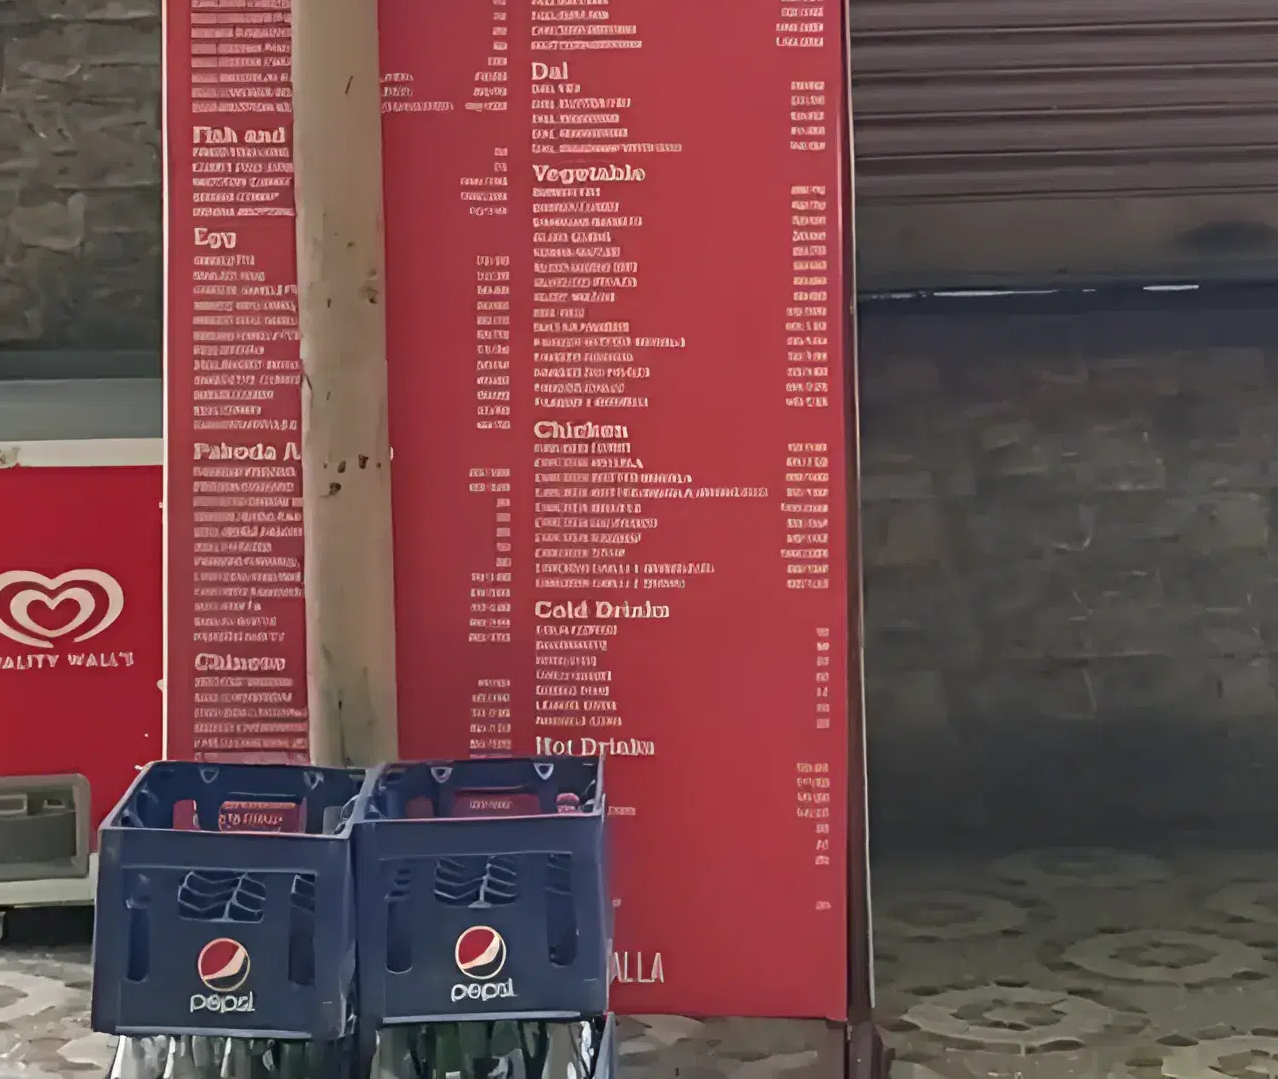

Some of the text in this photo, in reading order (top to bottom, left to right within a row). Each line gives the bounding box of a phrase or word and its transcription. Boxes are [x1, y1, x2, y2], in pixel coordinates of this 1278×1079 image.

[531, 61, 569, 81] Dal
[192, 126, 286, 144] Fish and
[532, 163, 646, 185] Vegetable
[533, 420, 629, 439] Chicken
[534, 600, 588, 619] Cold
[535, 736, 573, 757] Hot
[451, 977, 518, 1002] pepsi
[190, 991, 255, 1013] pepsi
